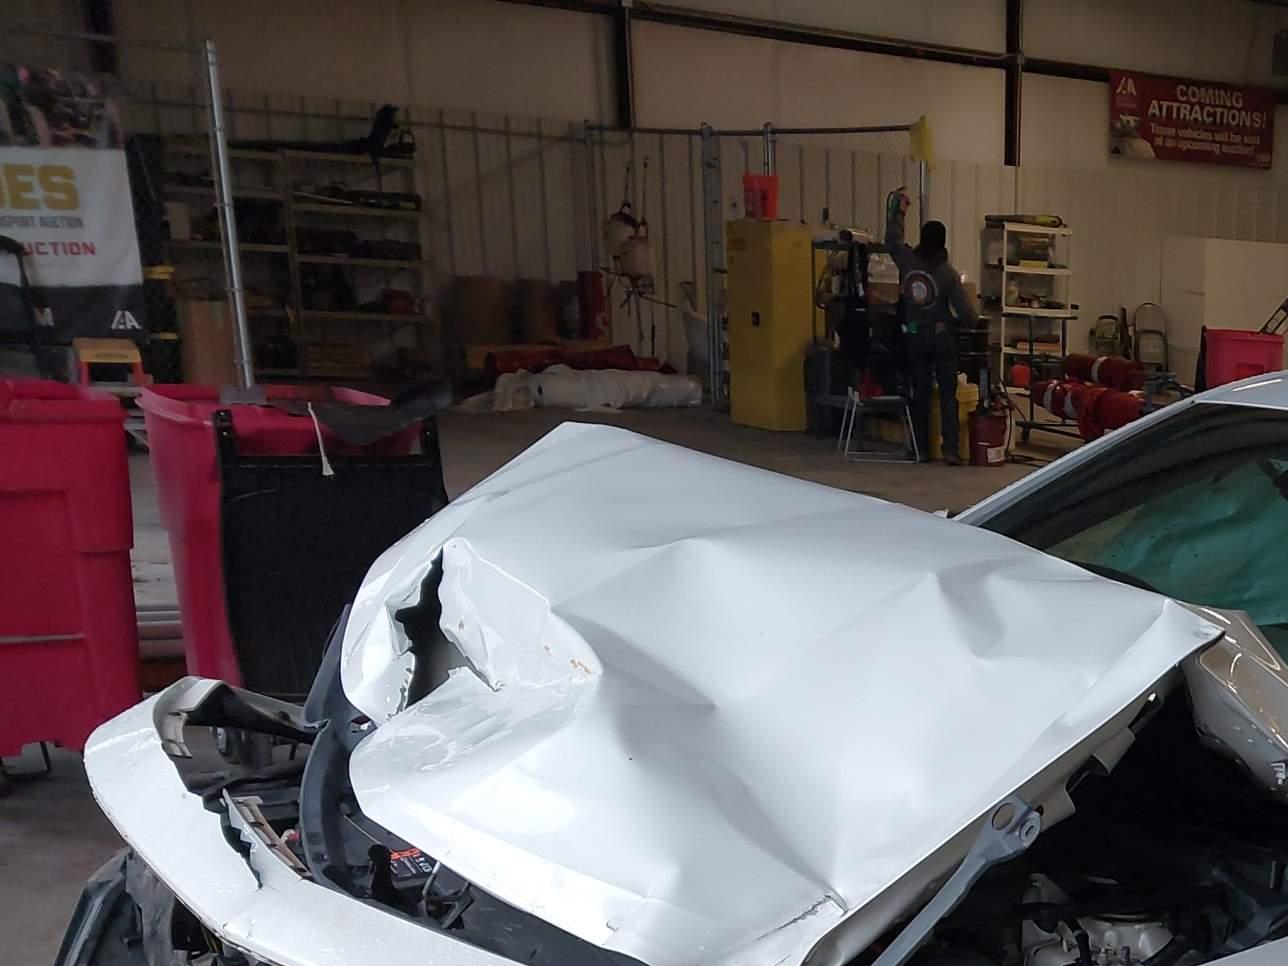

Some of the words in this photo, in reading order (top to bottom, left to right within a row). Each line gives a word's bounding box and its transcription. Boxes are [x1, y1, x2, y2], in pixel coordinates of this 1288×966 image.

[1176, 84, 1243, 108] COMING
[1148, 100, 1266, 128] ATTRACTIONS!
[0, 163, 81, 211] ES
[22, 240, 96, 256] UCTION
